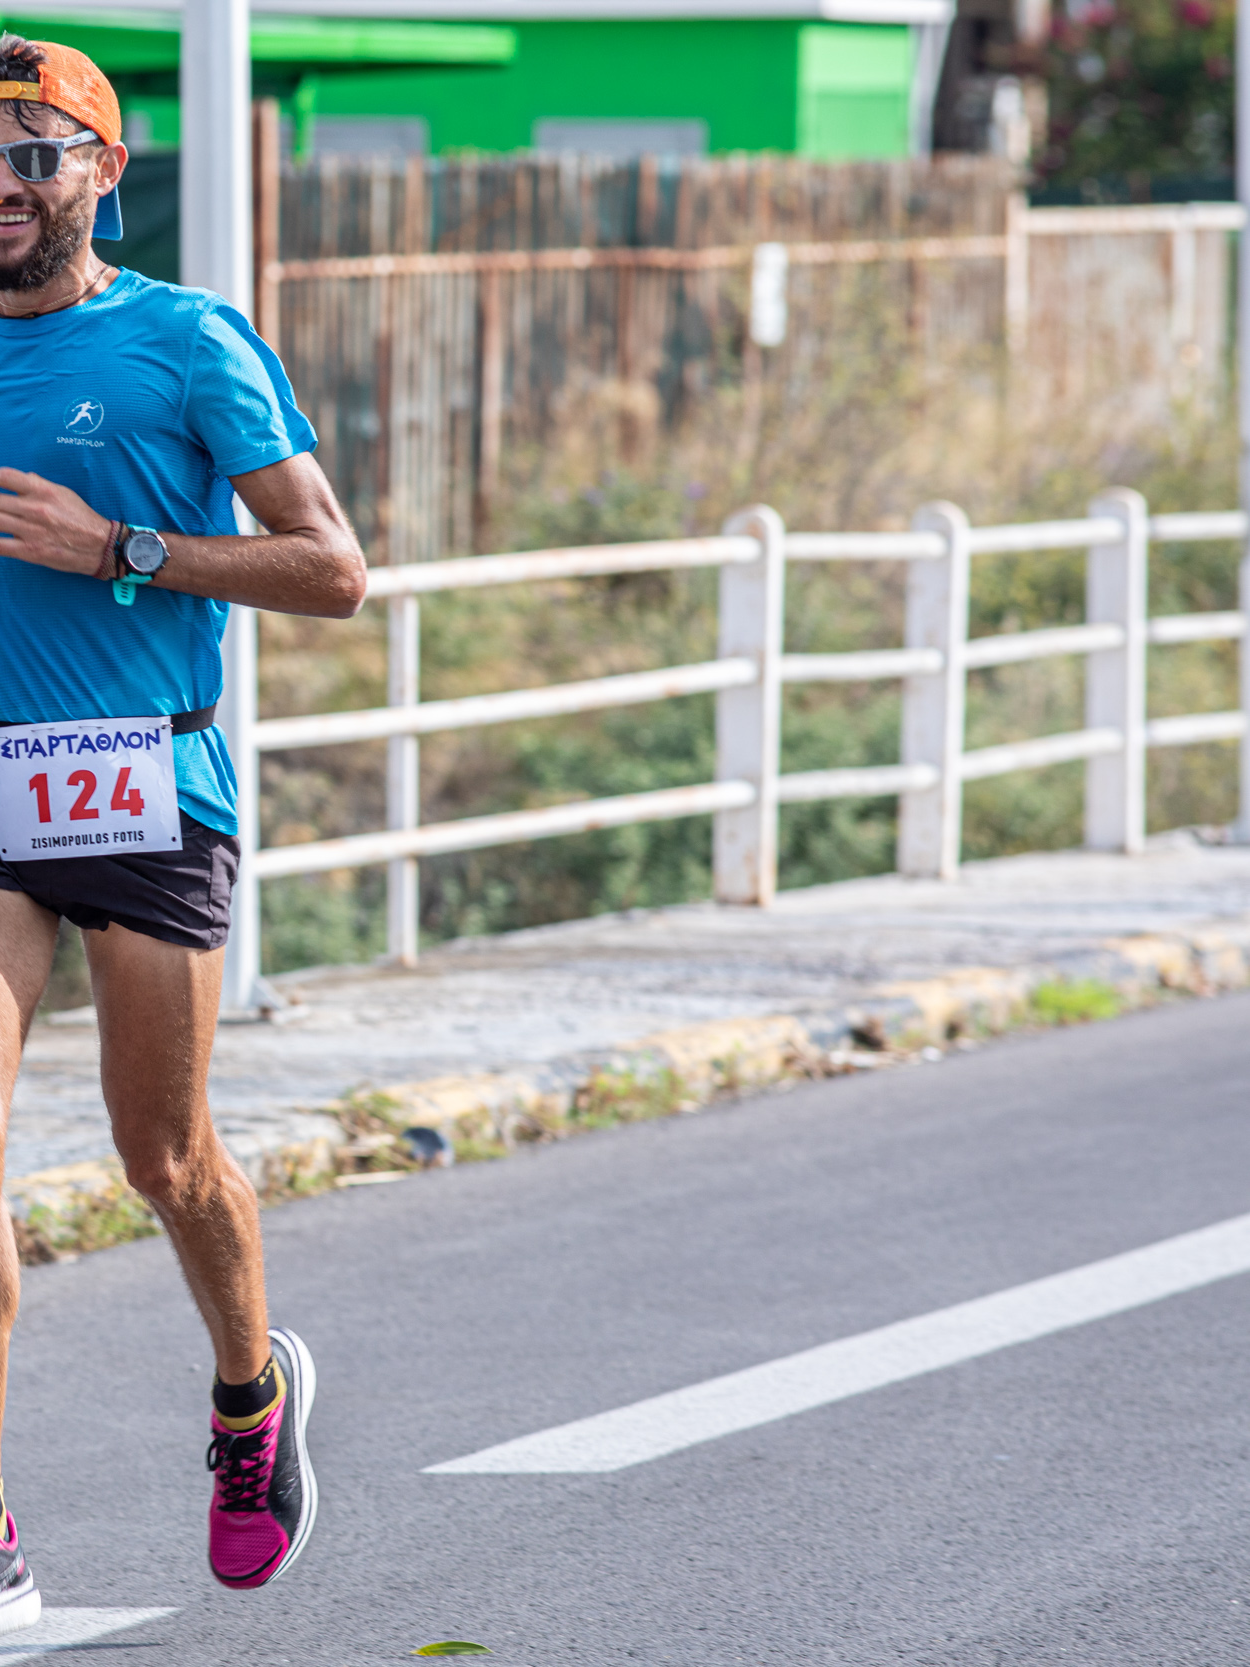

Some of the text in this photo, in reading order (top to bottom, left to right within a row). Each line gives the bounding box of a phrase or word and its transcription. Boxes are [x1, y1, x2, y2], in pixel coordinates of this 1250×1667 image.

[56, 436, 105, 448] SPARTATHLON
[0, 728, 161, 760] ΣΠΑΡΤΑΘΛΟΝ
[28, 766, 145, 824] 124
[31, 830, 145, 849] ZISIMOPOULOS FOTIS
